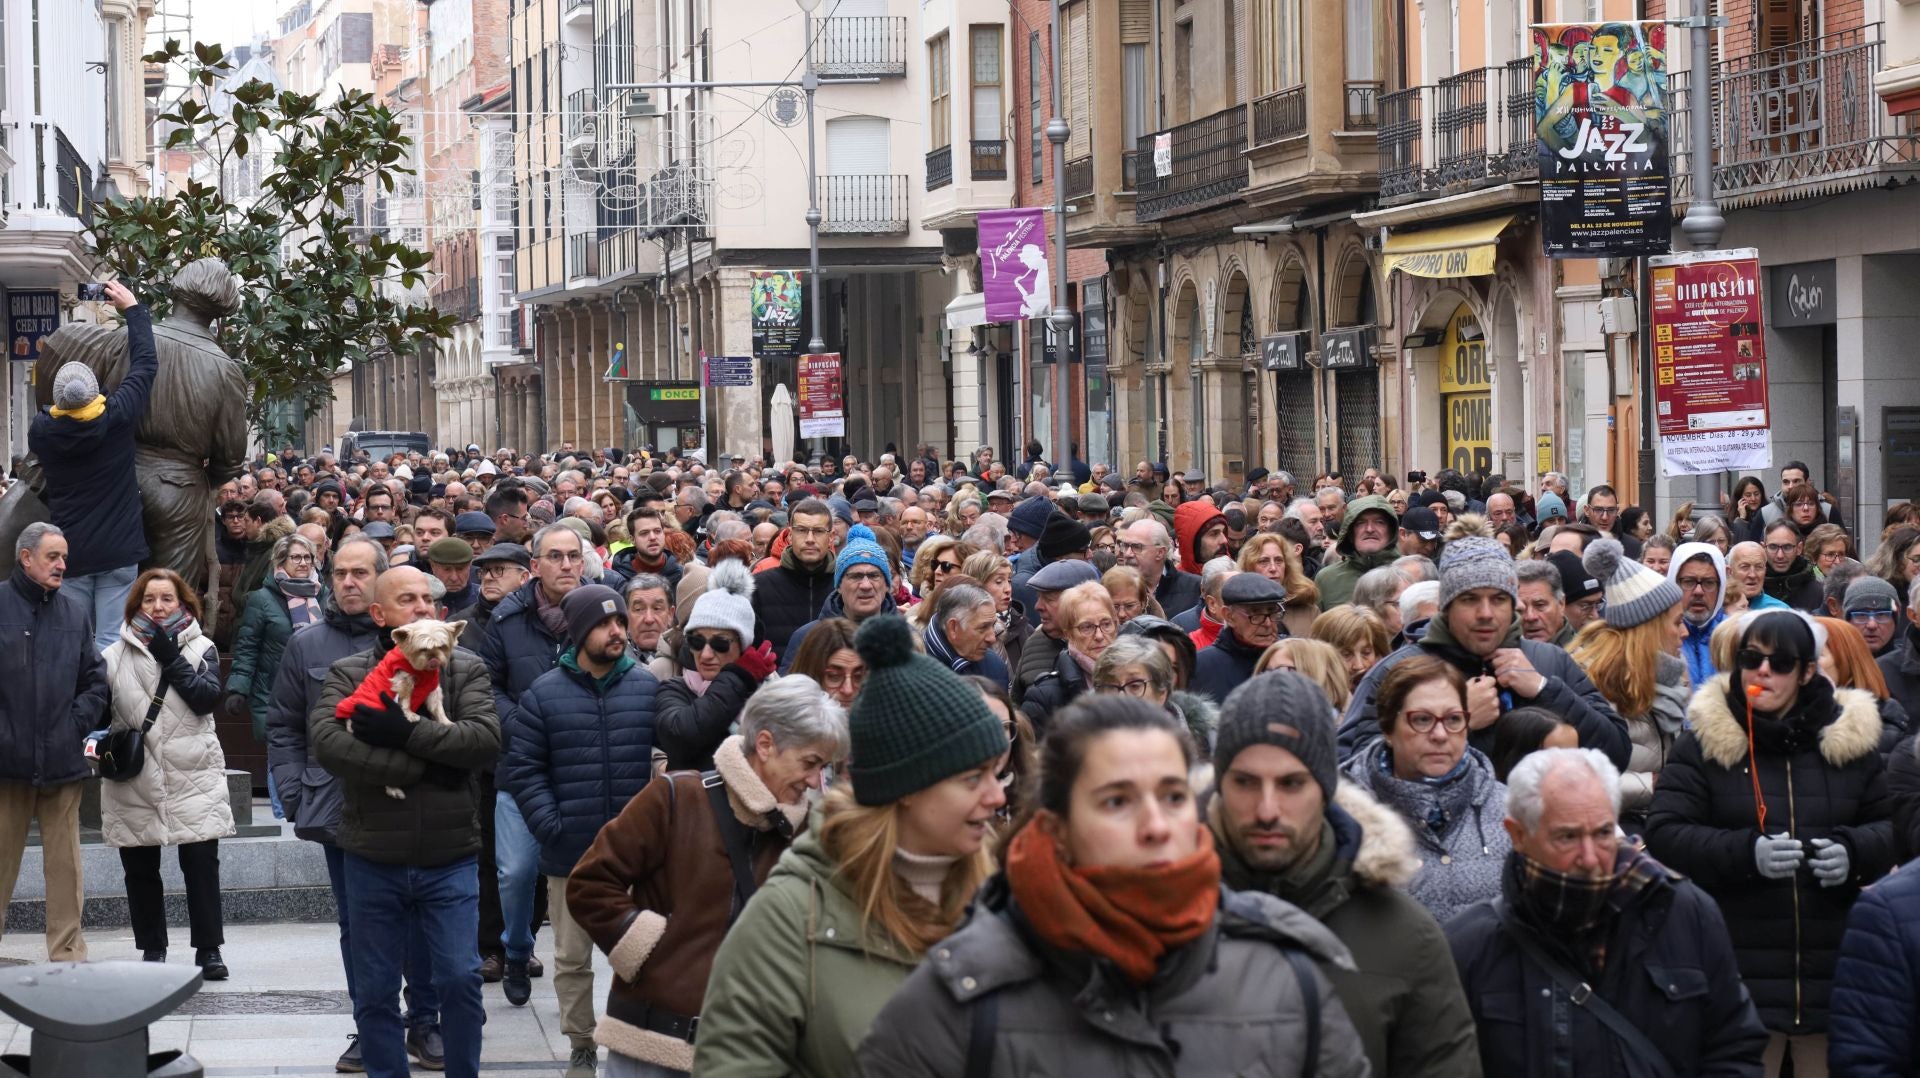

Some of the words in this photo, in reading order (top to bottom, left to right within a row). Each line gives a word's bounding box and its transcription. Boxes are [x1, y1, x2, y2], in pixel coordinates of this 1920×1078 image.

[1599, 104, 1648, 113] INTERNACIONAL
[1558, 118, 1648, 161] JAZZ
[1570, 228, 1644, 237] www.jazzpalencia.es
[1611, 220, 1643, 228] NOVIEMBRE
[988, 217, 1029, 279] jazz
[999, 239, 1020, 263] PALENCIA
[1446, 250, 1468, 274] ORO
[1677, 277, 1755, 301] DIAPASIÓN
[11, 295, 31, 316] GRAN
[32, 295, 55, 315] BAZAR
[759, 306, 794, 323] JAZZ
[15, 318, 38, 333] CHEN
[41, 318, 52, 332] FU
[665, 390, 695, 398] ONCE
[1666, 433, 1706, 442] NOVIEMBRE
